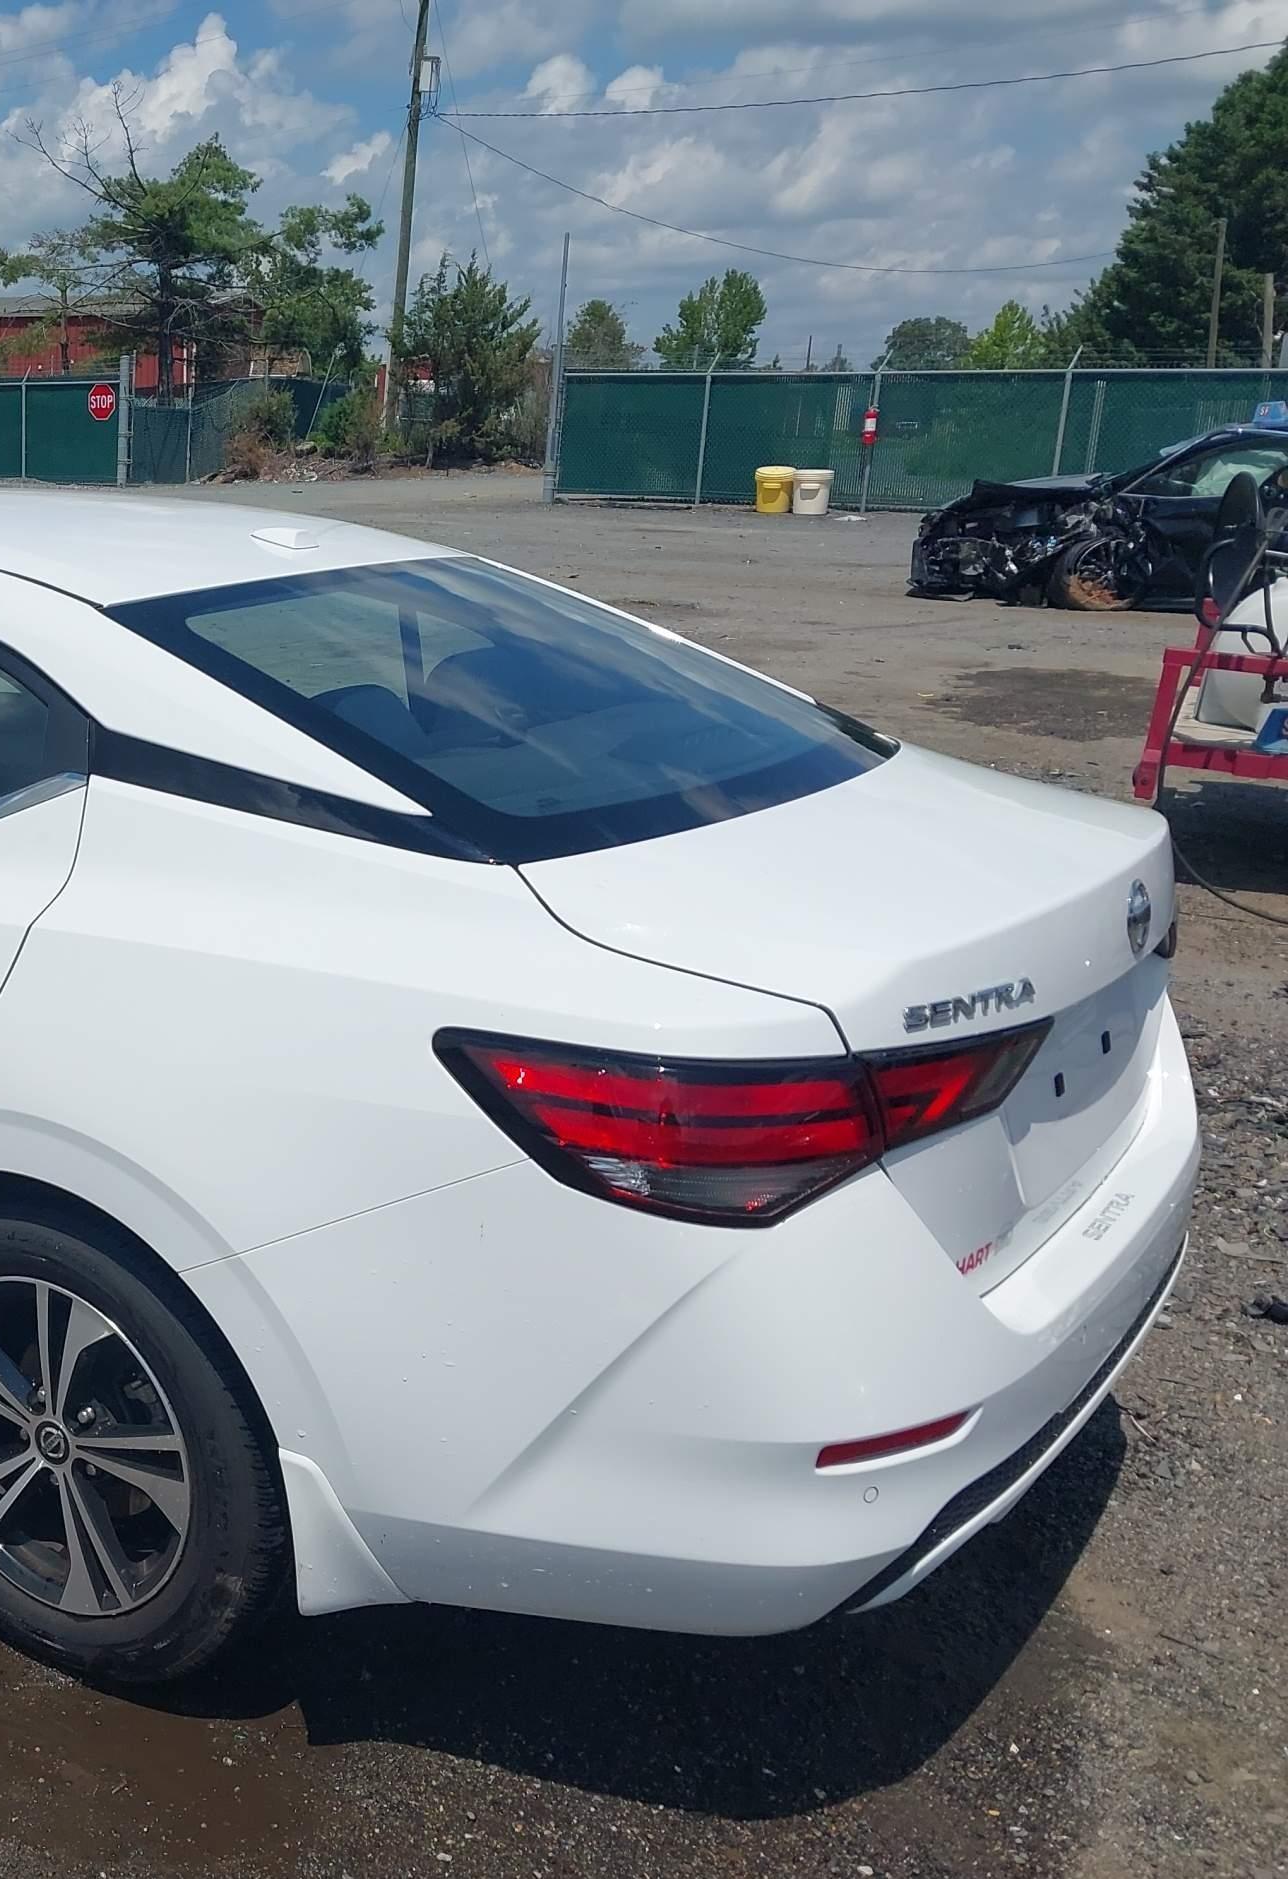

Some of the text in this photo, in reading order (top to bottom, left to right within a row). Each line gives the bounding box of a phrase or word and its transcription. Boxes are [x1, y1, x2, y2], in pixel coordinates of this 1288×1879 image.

[90, 395, 113, 409] STOP
[903, 977, 1036, 1033] SENTRA
[1082, 1192, 1136, 1241] SENTRA
